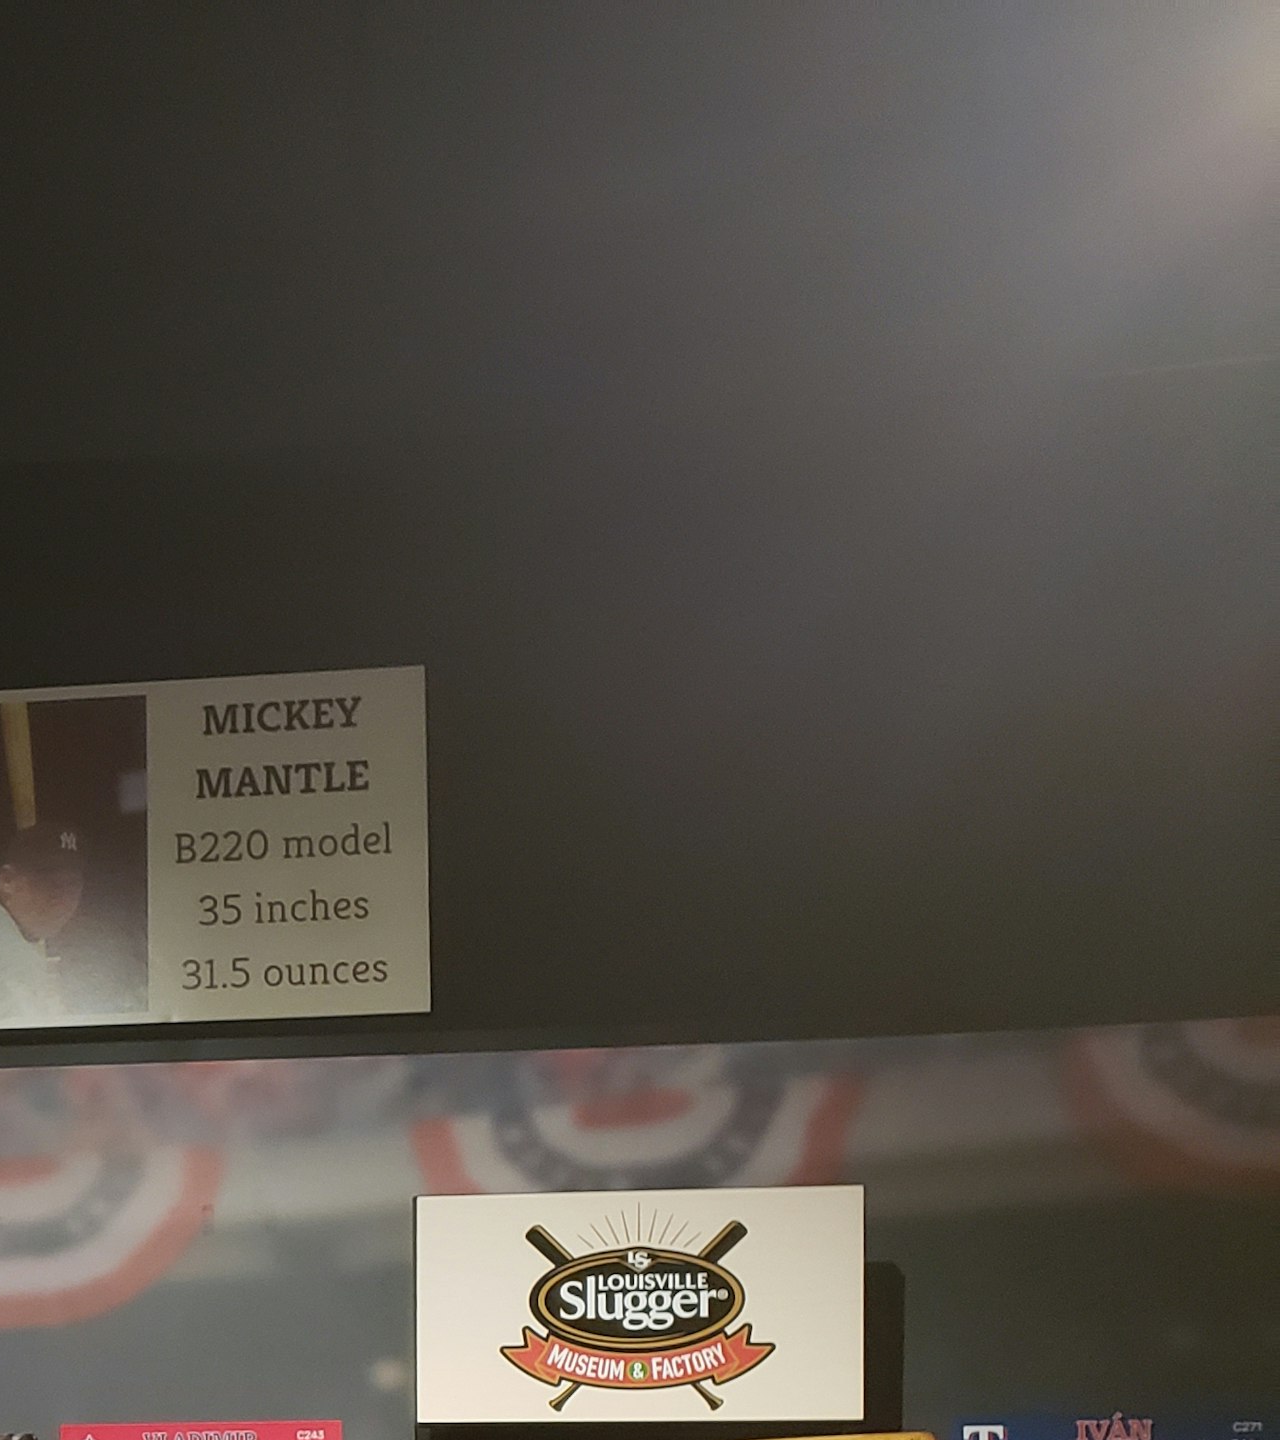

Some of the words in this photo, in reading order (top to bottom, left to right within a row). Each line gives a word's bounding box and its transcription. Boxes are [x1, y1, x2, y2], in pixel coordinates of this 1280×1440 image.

[203, 697, 362, 736] MICKEY
[196, 761, 369, 799] MANTLE
[175, 829, 269, 864] B220
[283, 823, 392, 859] model
[199, 895, 242, 925] 35
[255, 891, 369, 924] inches
[182, 958, 250, 990] 31.5
[264, 959, 388, 987] ounces
[598, 1273, 707, 1290] LOUISVILLE
[547, 1344, 624, 1380] MUSEUM
[632, 1363, 643, 1379] &
[652, 1343, 725, 1379] FACTORY
